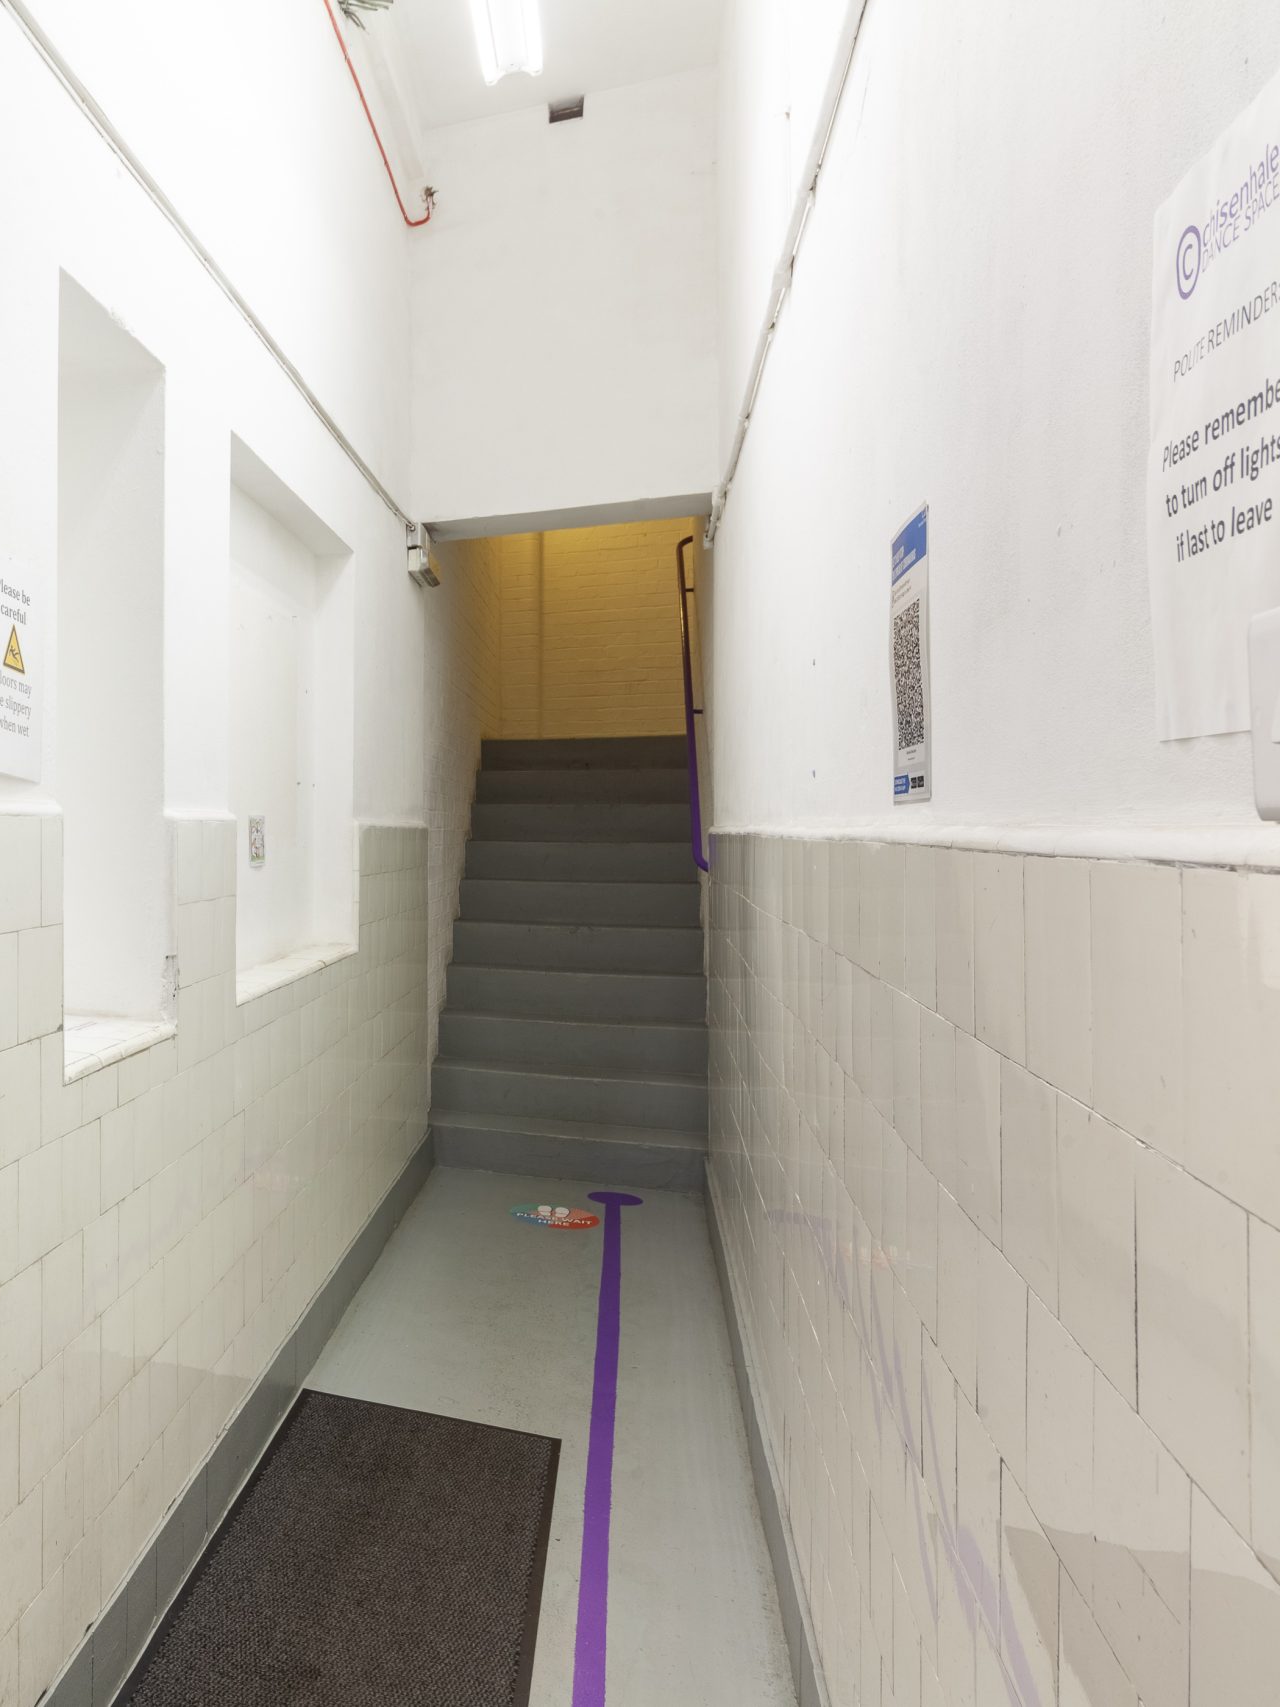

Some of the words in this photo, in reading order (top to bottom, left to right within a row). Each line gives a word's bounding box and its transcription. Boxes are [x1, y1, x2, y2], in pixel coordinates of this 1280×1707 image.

[1202, 143, 1280, 248] chisenhale
[1201, 214, 1241, 274] DANCE
[1243, 170, 1280, 232] SPACE
[1173, 336, 1205, 383] POLITE
[1163, 429, 1199, 473] Please
[1165, 493, 1179, 518] to
[1181, 475, 1207, 509] turn
[1212, 452, 1236, 492] off
[1176, 533, 1185, 563] if
[1186, 524, 1209, 557] last
[1211, 519, 1225, 545] to
[1230, 497, 1273, 538] leave
[0, 603, 27, 625] careful
[21, 589, 31, 607] be
[5, 694, 32, 720] slippery
[18, 681, 32, 699] may
[17, 724, 30, 738] wet
[561, 1217, 593, 1225] WAIT
